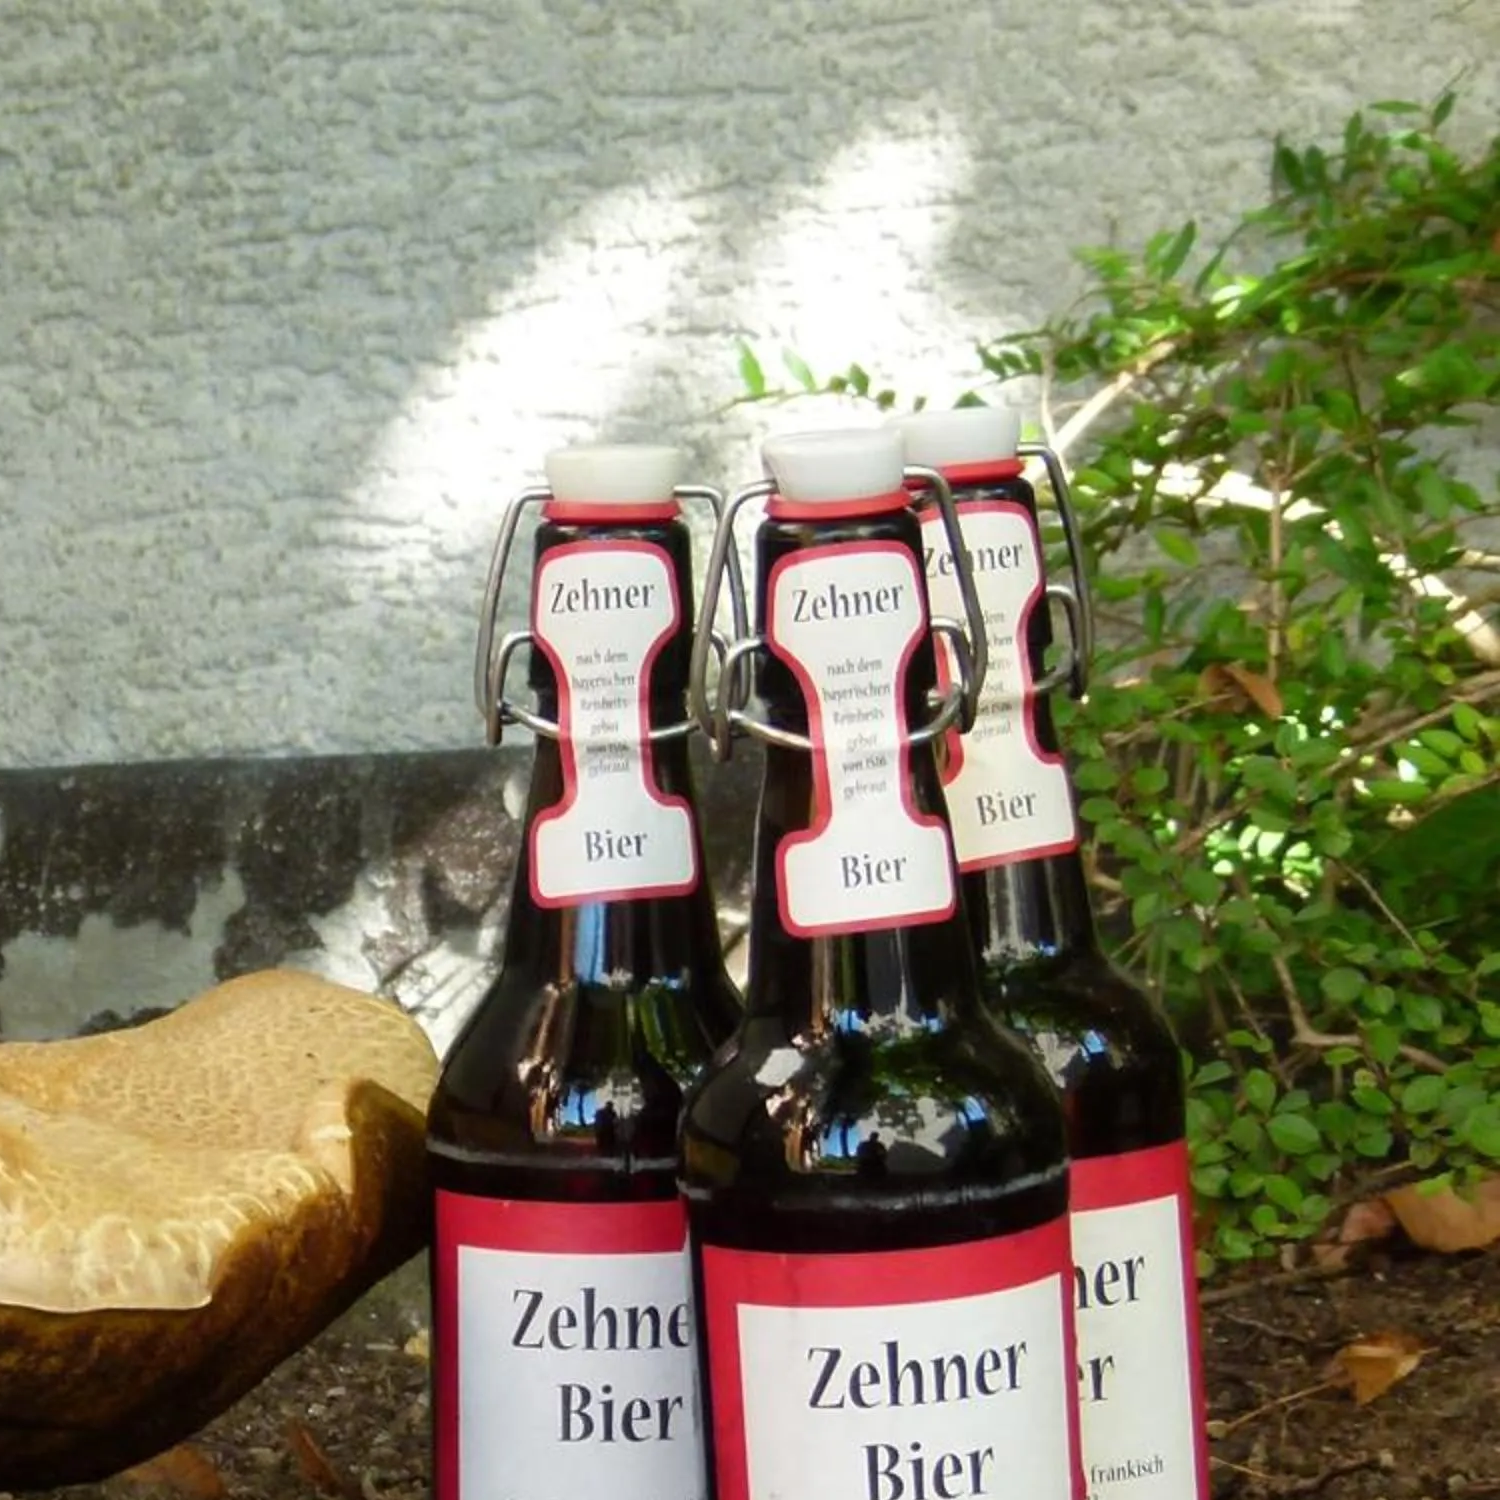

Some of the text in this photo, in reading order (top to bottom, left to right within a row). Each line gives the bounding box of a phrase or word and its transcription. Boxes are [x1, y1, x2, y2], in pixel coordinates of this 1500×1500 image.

[925, 543, 1023, 577] Zener
[551, 579, 655, 613] Zehner
[792, 583, 904, 622] Zehner
[827, 657, 882, 676] nach dem
[976, 791, 1036, 826] Bier
[584, 831, 648, 862] Bier
[841, 853, 907, 889] Bier
[1074, 1256, 1145, 1310] ner
[512, 1288, 691, 1351] Zehne
[807, 1340, 1028, 1409] Zehner
[558, 1384, 683, 1442] Bier
